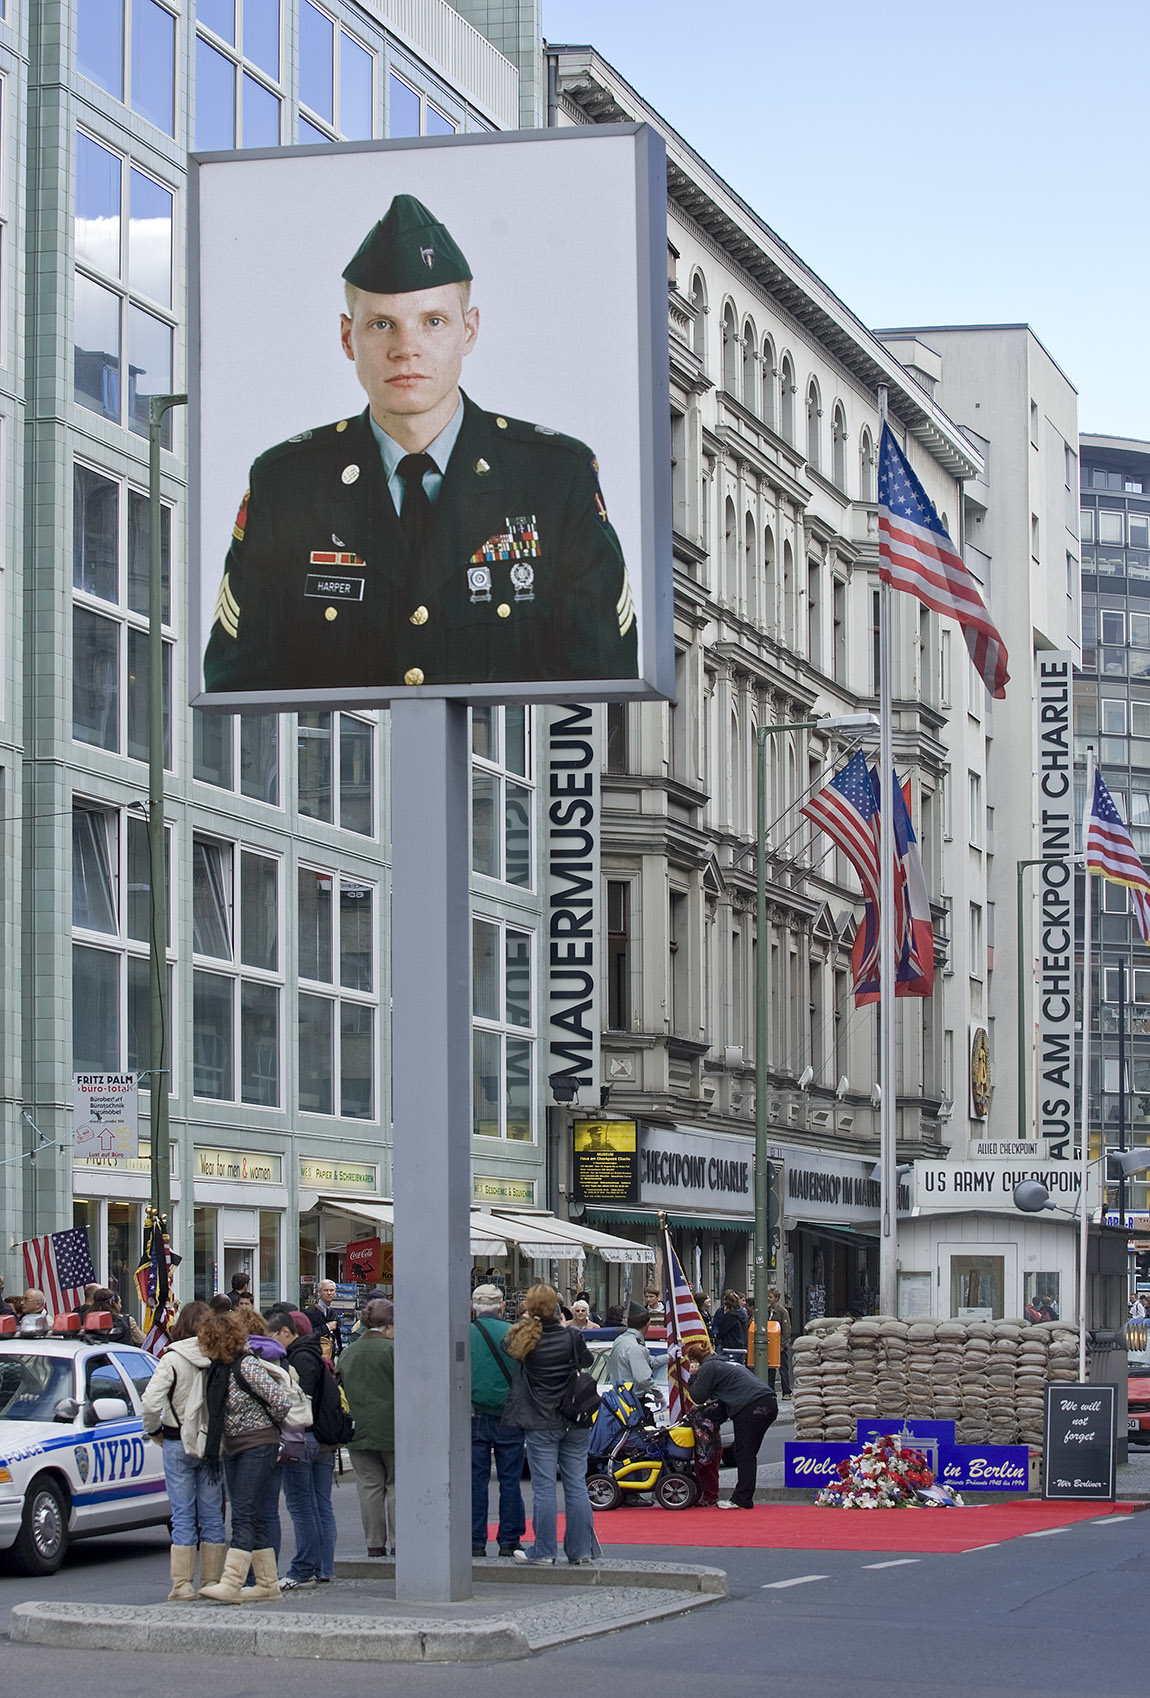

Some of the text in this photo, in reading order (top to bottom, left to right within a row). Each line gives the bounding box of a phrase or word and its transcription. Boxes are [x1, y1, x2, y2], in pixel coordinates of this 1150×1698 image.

[317, 581, 351, 593] HARPER
[550, 703, 594, 1086] MAUERMUSEUM
[1041, 662, 1070, 1160] AUS AM CHECKPOINT CHARLIE
[77, 1076, 133, 1084] FRITZ PALM
[977, 1142, 1039, 1155] ALLIED CHECKPOINT
[200, 1154, 271, 1180] Wear for men & women
[334, 1170, 338, 1180] &
[640, 1148, 706, 1189] CHECKPOINT
[708, 1157, 748, 1194] CHARLIE
[789, 1168, 841, 1204] MAUERSHOP
[843, 1176, 853, 1205] IM
[954, 1172, 995, 1192] ARMY
[1060, 1400, 1102, 1411] We will
[1072, 1417, 1089, 1426] not
[1064, 1430, 1095, 1443] forget
[4, 1444, 43, 1464] POLICE
[92, 1437, 144, 1483] NYPD
[792, 1456, 1024, 1478] Welc in Berlin
